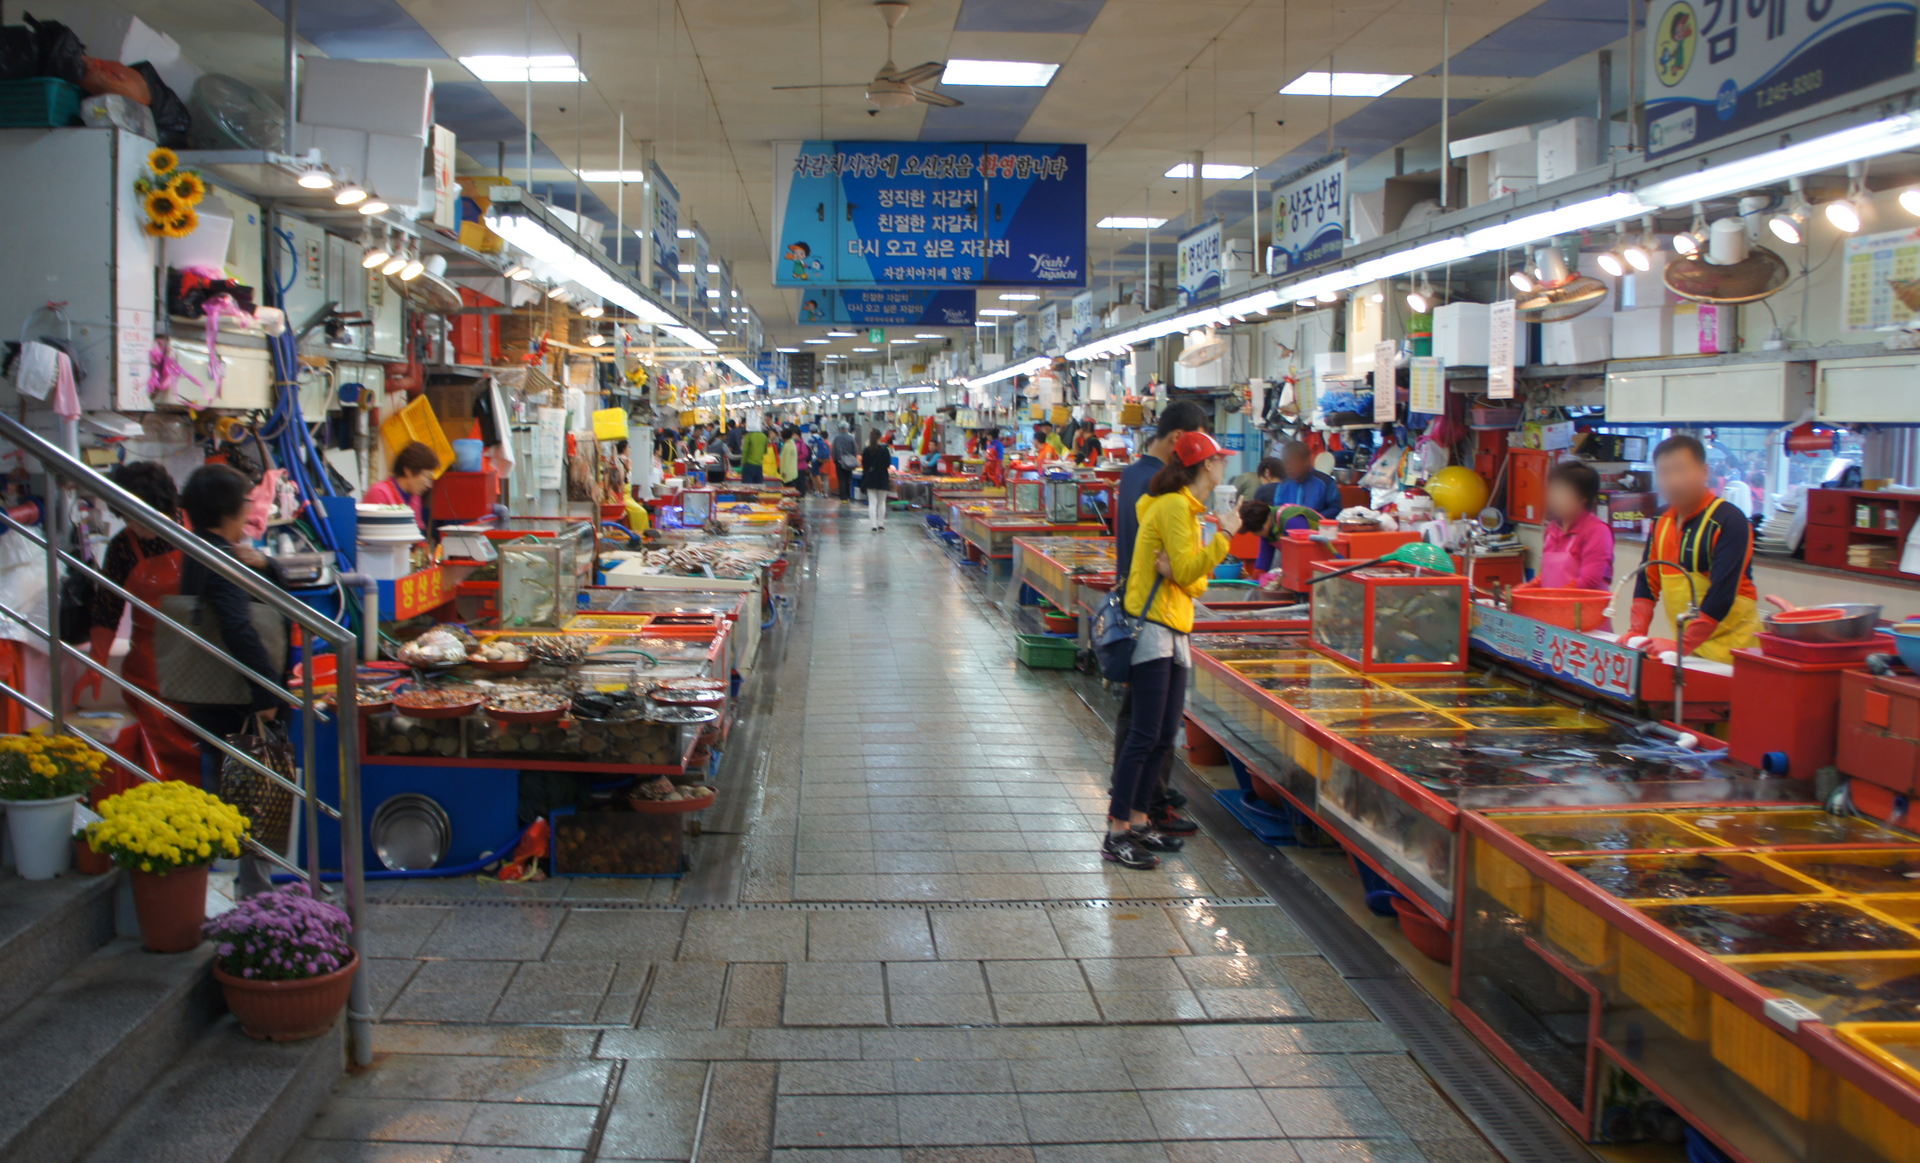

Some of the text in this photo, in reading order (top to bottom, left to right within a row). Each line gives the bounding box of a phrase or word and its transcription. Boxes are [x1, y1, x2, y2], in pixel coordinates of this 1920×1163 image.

[793, 153, 1068, 181] 자갈치시장에 오신것을 환영합니다
[878, 189, 978, 209] 정직한 자갈치
[1289, 174, 1341, 233] 상주상회
[878, 213, 978, 234] 친절한 자갈치
[848, 238, 1010, 259] 다시 오고 싶은 자갈치
[883, 266, 973, 281] 자갈치아지매 일동
[1028, 253, 1071, 273] Yeah!
[1549, 635, 1633, 697] 상주상회
